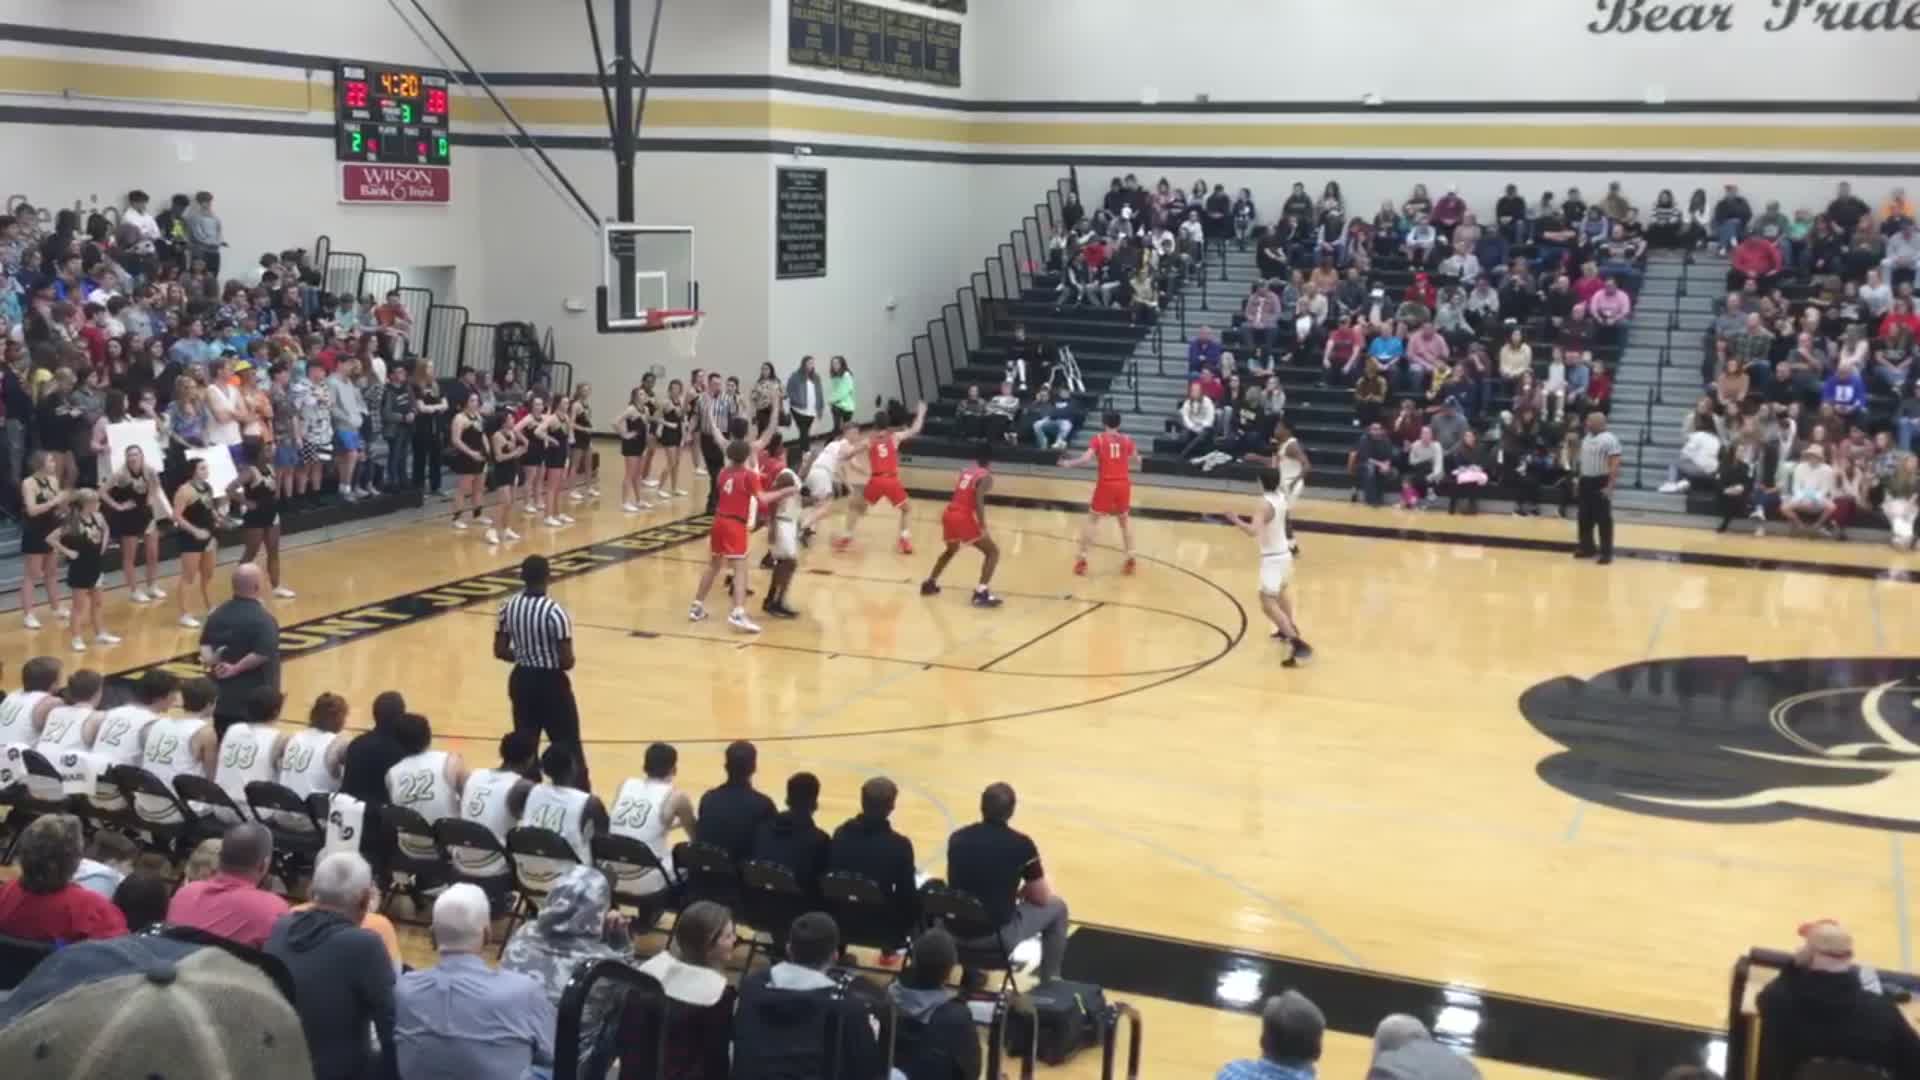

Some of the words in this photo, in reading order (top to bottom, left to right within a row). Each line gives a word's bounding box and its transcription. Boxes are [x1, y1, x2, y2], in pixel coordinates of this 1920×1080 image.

[1587, 0, 1733, 33] Bear
[381, 73, 419, 97] 4:20
[401, 104, 411, 124] 3
[351, 132, 361, 152] 2
[363, 168, 433, 184] WILSON
[877, 443, 889, 459] 5
[1109, 442, 1121, 459] 11
[723, 478, 735, 495] 4
[223, 743, 259, 770] 33
[284, 743, 314, 774] 20
[400, 770, 435, 801] 22
[470, 787, 490, 817] 5
[613, 797, 653, 828] 23
[532, 803, 565, 832] 44
